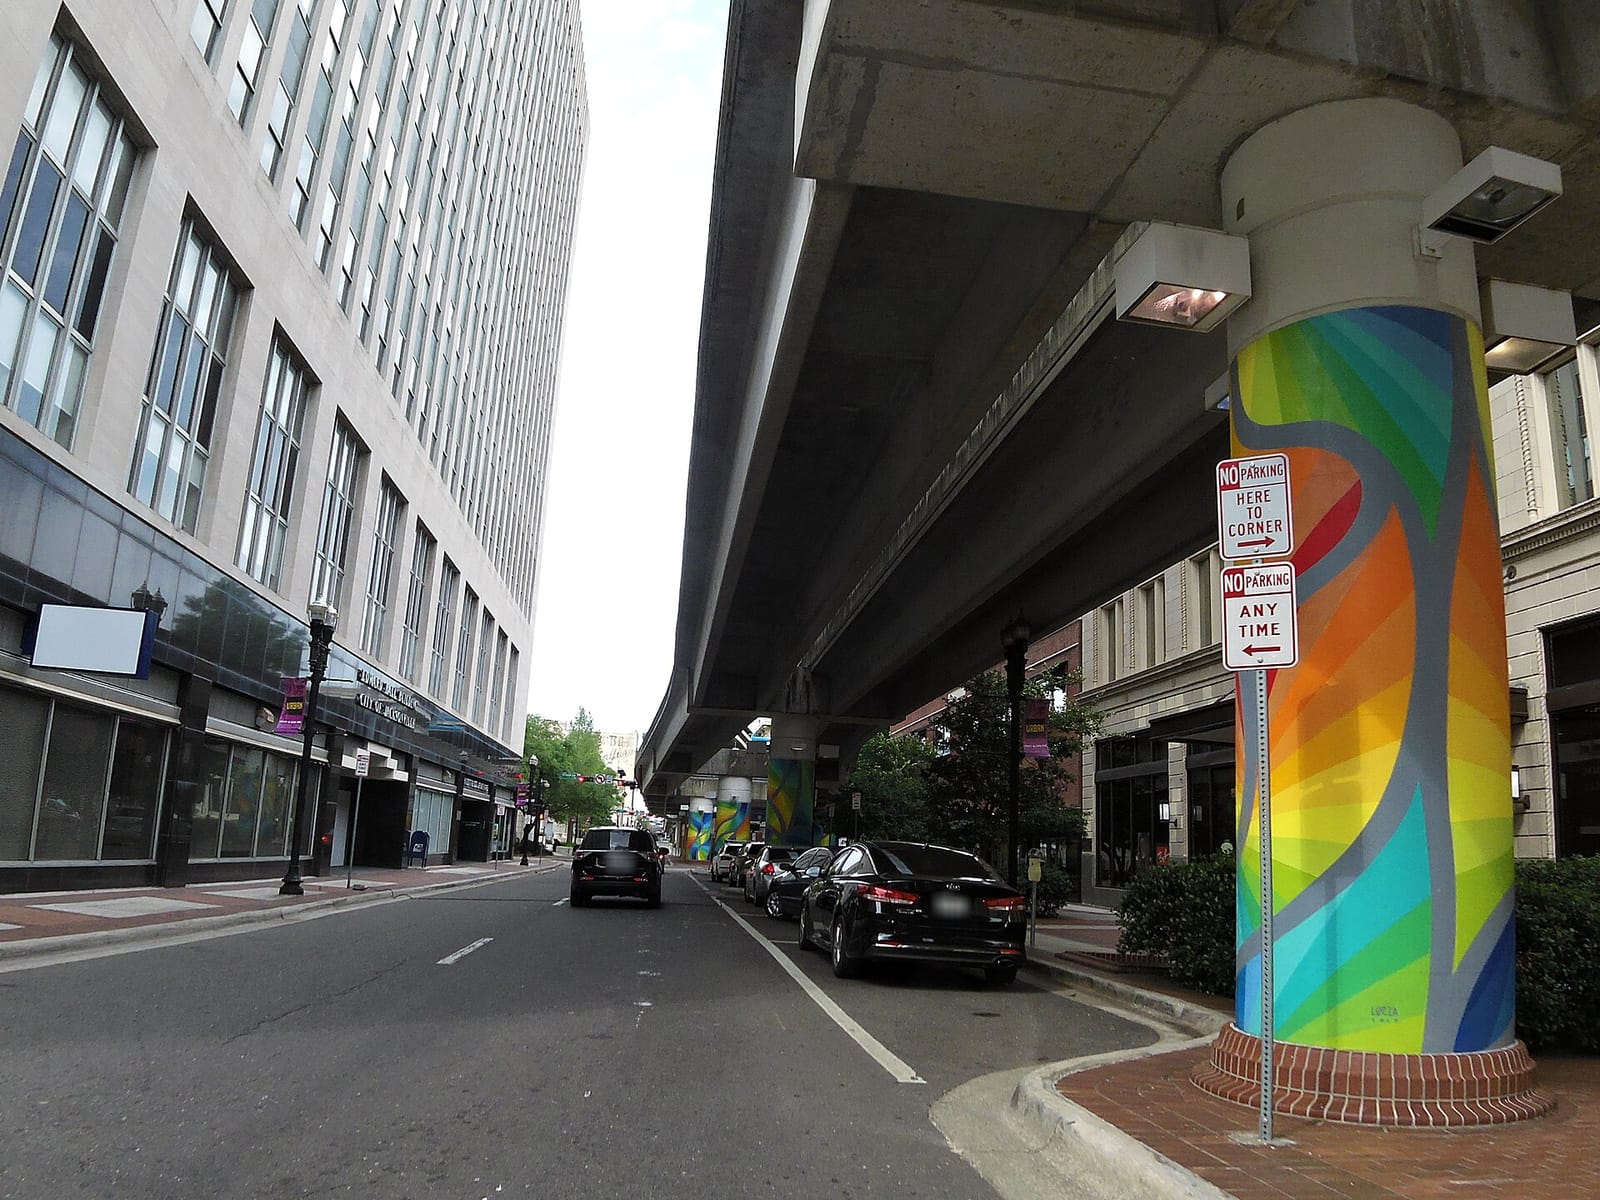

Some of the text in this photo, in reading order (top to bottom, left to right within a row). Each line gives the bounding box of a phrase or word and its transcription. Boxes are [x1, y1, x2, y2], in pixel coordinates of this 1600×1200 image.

[1220, 463, 1284, 486] NO PARKING
[1236, 489, 1271, 506] HERE
[1246, 506, 1263, 519] TO
[1228, 519, 1283, 537] CORNER
[1224, 572, 1290, 593] NO PARKING
[1239, 603, 1278, 618] ANY
[1238, 623, 1281, 638] TIME
